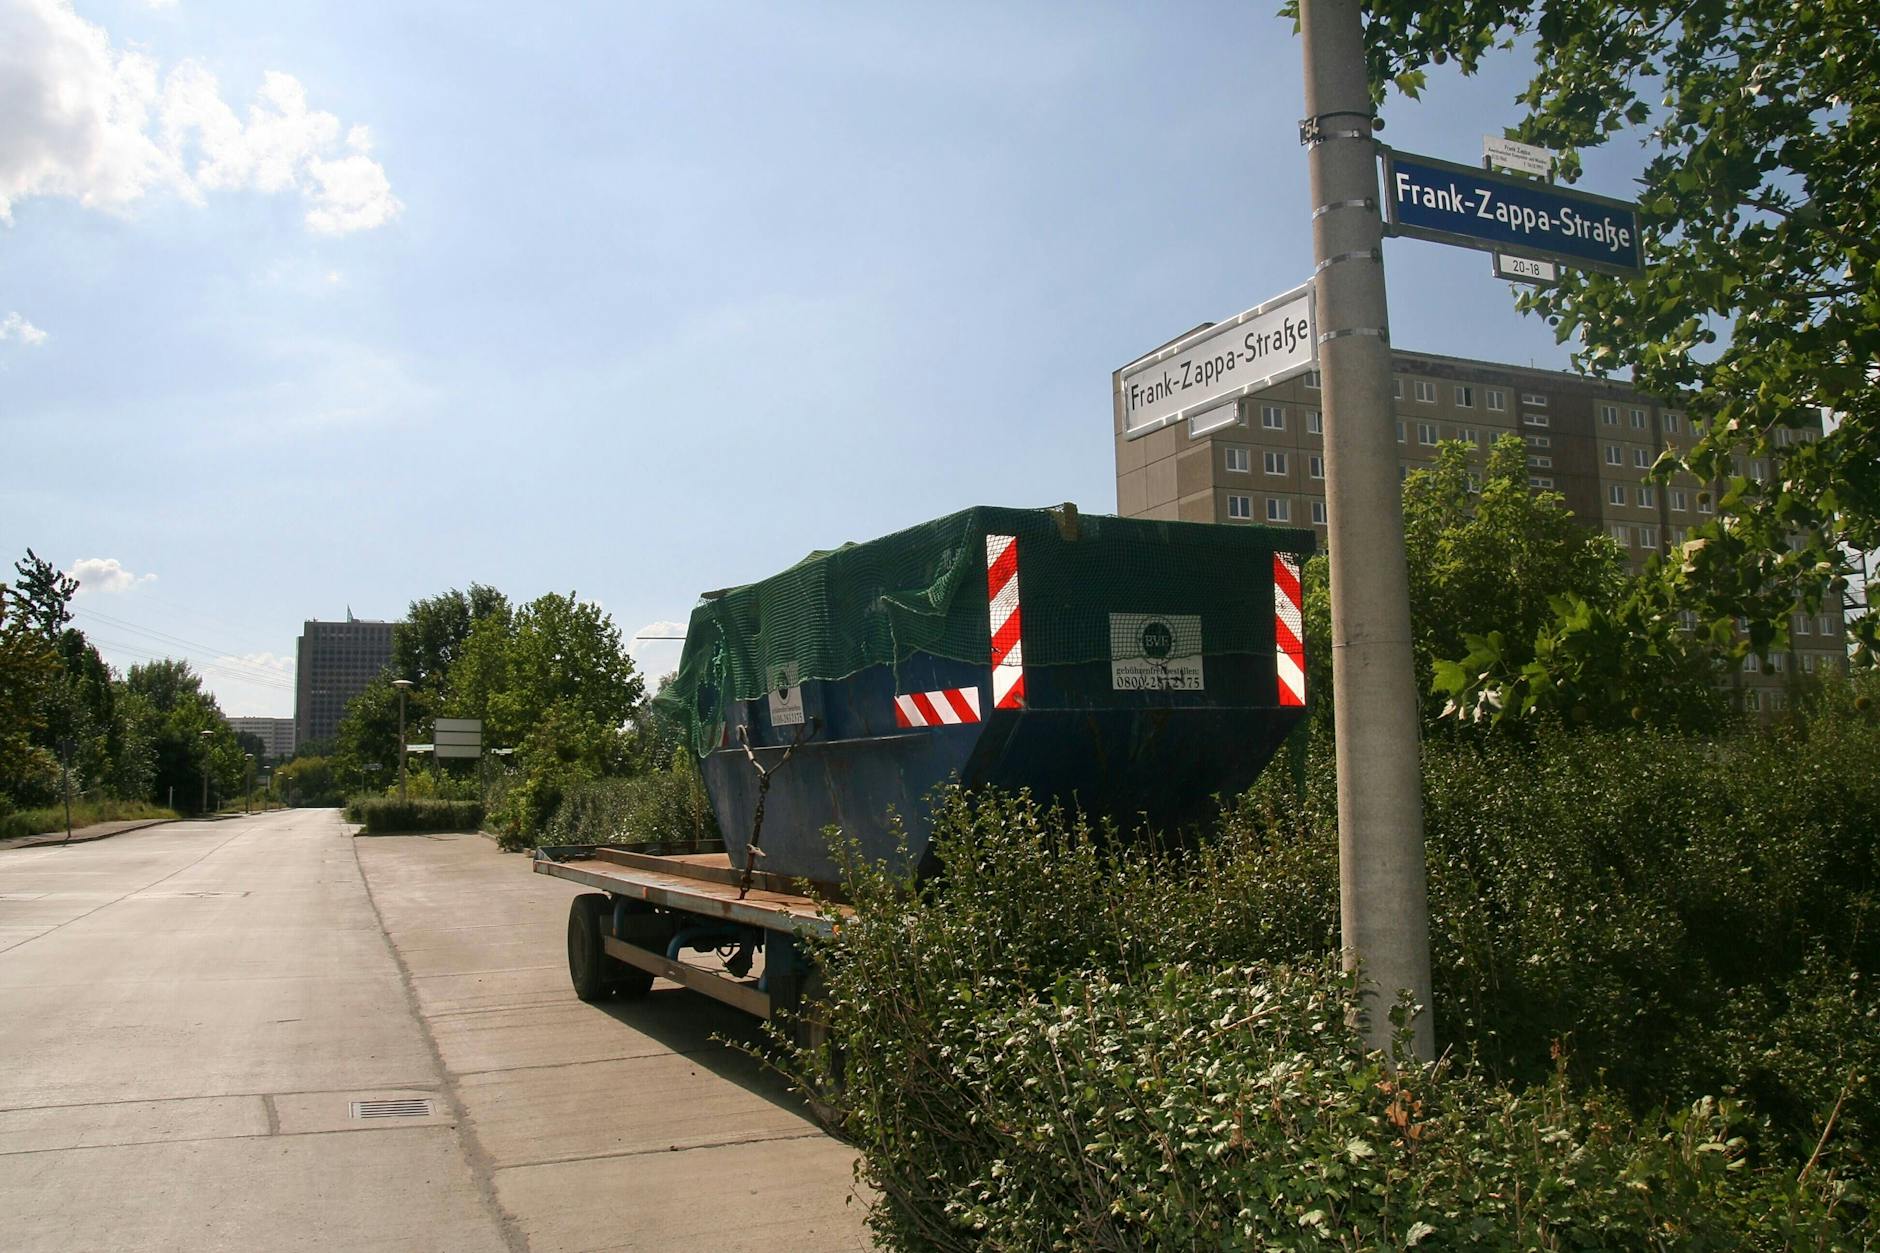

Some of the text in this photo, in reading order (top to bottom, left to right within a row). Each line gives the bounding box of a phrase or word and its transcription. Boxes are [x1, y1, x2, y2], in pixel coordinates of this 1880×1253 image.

[1396, 172, 1630, 252] Frank-Zappa-Straße
[1512, 259, 1540, 276] 20-18
[1130, 317, 1308, 410] Frank-Zappa-Straße
[1165, 666, 1200, 675] bestllen:
[1117, 676, 1200, 688] 0800-28275
